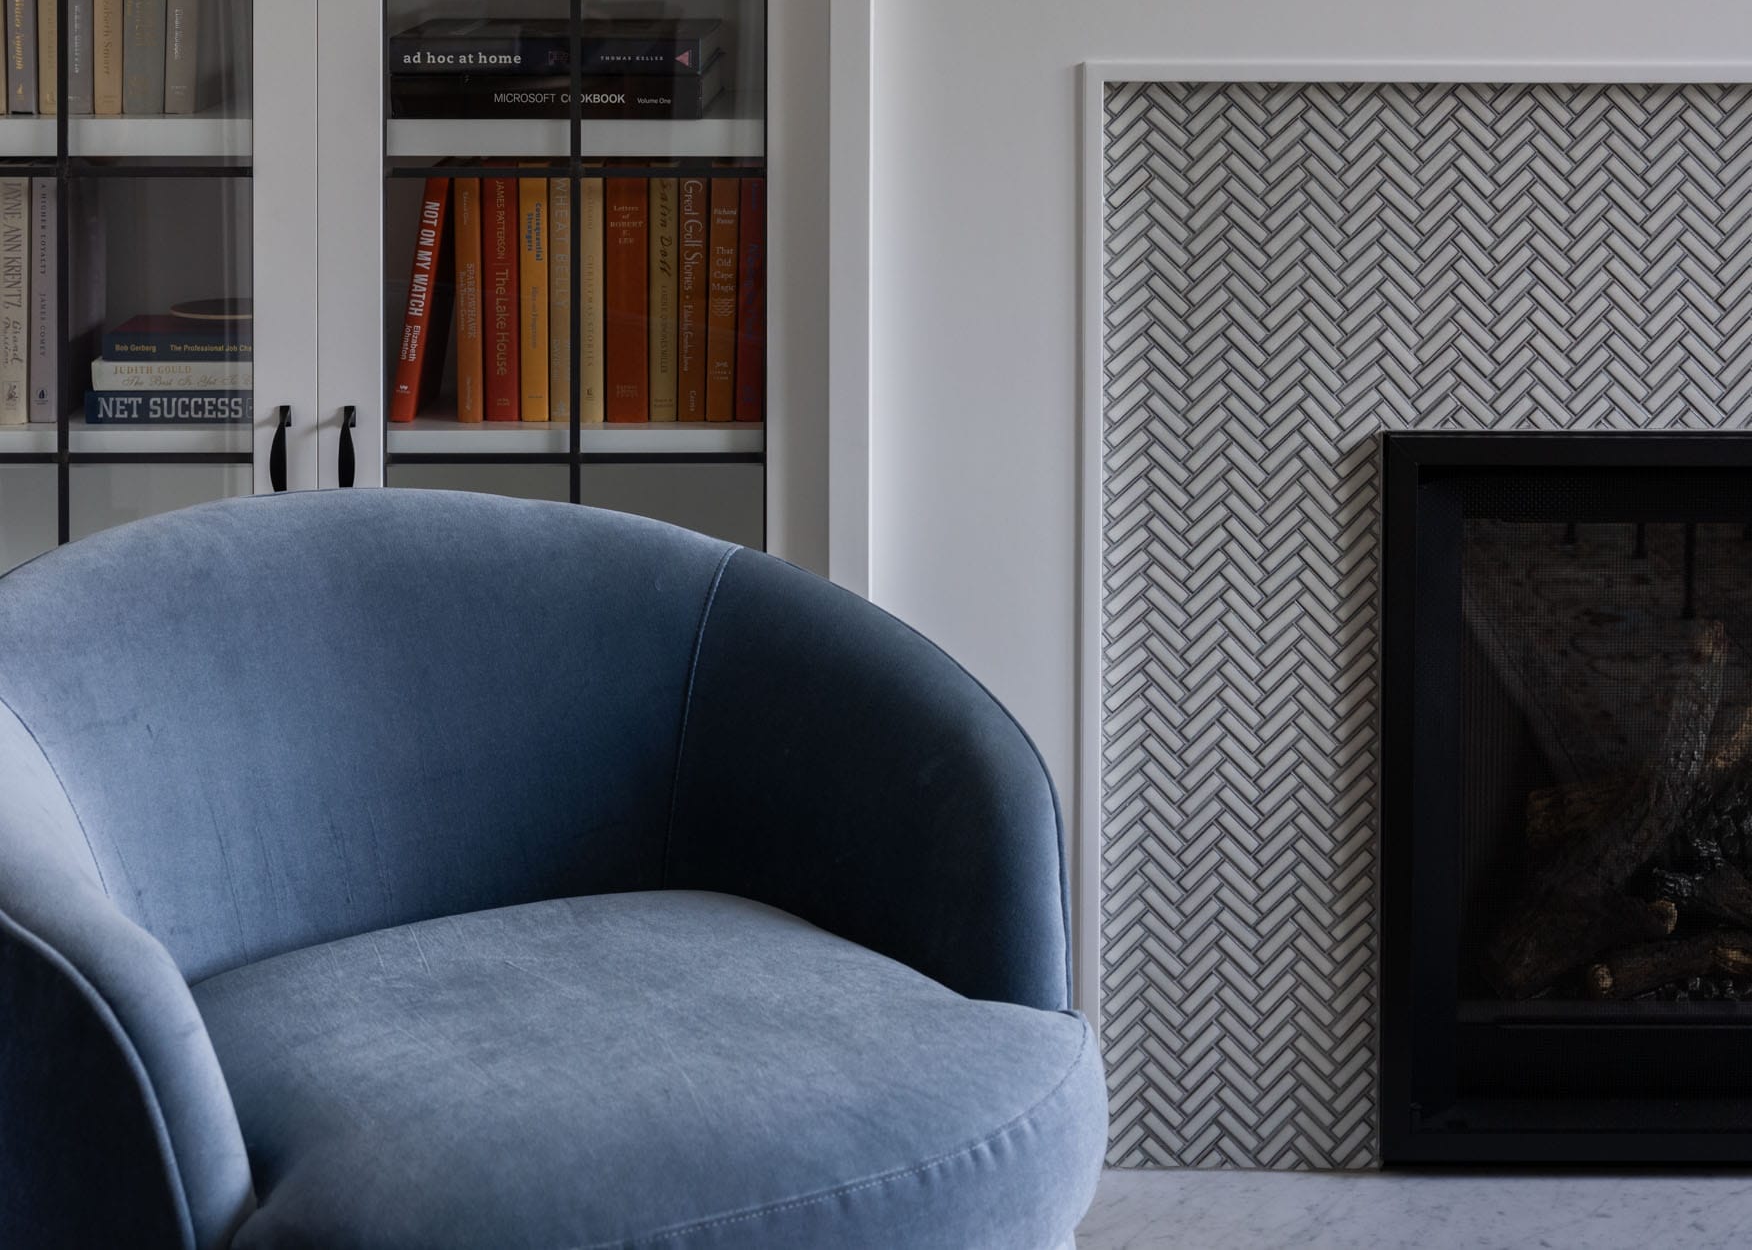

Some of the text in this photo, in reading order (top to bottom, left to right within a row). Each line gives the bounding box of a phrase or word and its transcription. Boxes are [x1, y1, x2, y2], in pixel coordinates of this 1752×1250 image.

[403, 52, 522, 64] ad hoc at home
[494, 93, 556, 103] MICROSOFT
[495, 180, 506, 260] JAMES PATTERSON
[2, 181, 22, 309] JAYNE ANN KRENTZ
[554, 178, 568, 310] WHEAT BELLY
[682, 180, 703, 291] Great Golf Stories
[409, 201, 441, 316] NOT ON MY WATCH
[715, 246, 735, 255] That
[716, 258, 732, 267] Old
[712, 283, 736, 294] Magic
[713, 270, 735, 282] Cape
[39, 293, 47, 321] JAMES
[495, 269, 511, 376] The Lake House
[400, 324, 413, 361] Johnston
[408, 325, 421, 362] Elizabeth
[113, 365, 192, 375] JUDITH GOULD
[98, 397, 142, 418] NET
[149, 397, 242, 418] SUCCESS
